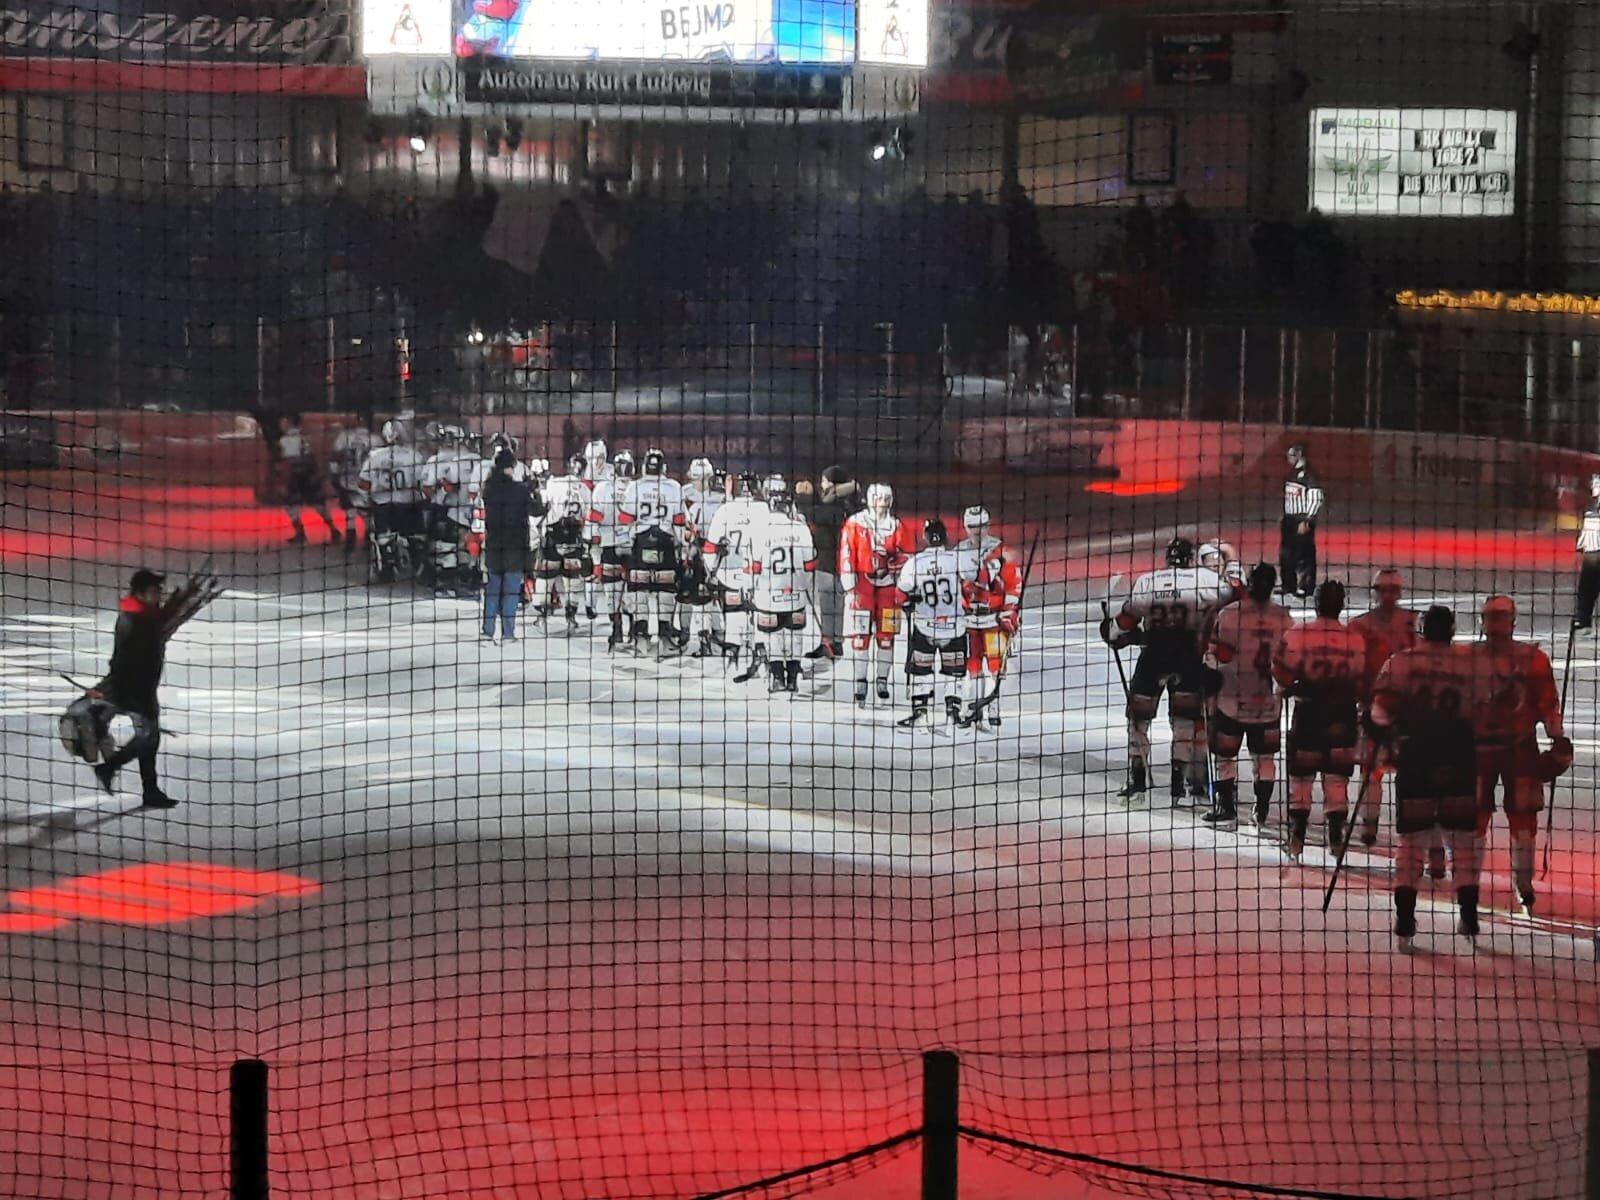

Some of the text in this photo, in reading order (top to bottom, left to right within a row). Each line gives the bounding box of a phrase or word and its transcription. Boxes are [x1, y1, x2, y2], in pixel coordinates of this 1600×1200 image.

[477, 69, 580, 89] Autohaus
[770, 546, 796, 575] 21
[922, 577, 953, 607] 83
